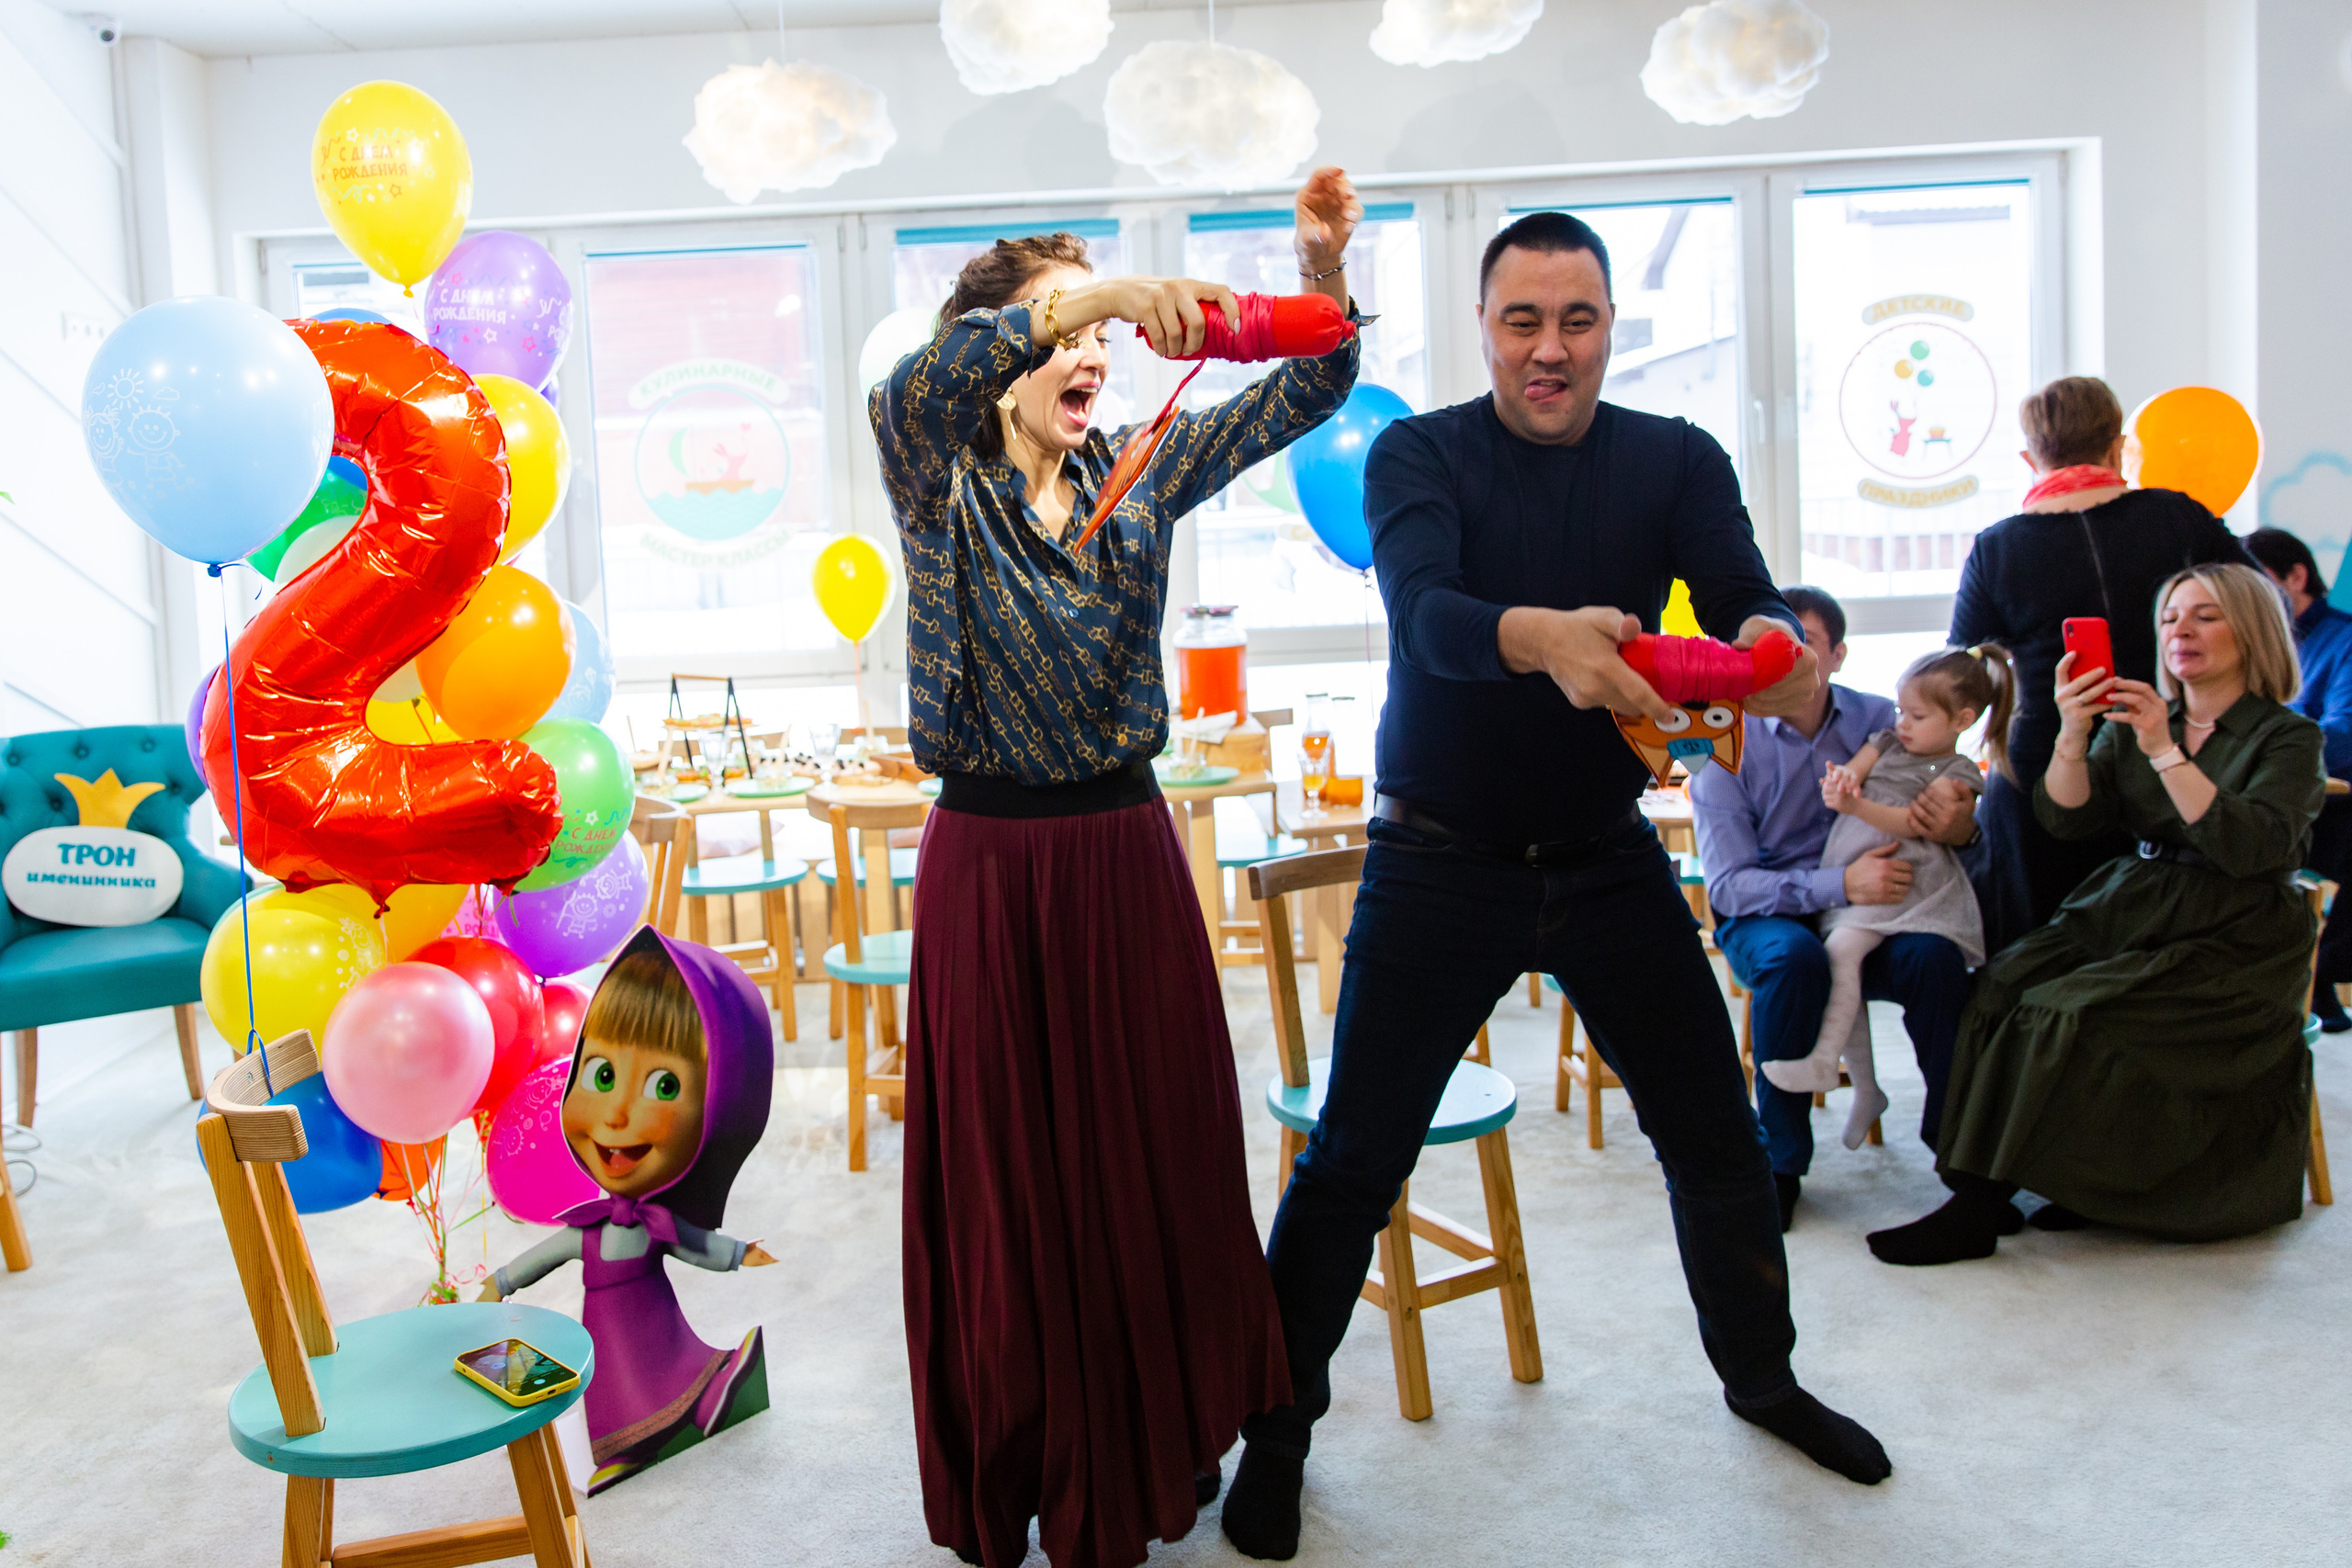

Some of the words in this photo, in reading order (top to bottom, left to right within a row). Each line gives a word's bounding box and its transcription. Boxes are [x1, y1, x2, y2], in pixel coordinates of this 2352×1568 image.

[339, 147, 346, 162] С
[333, 163, 408, 181] РОЖДЕНИЯ
[440, 288, 448, 303] С
[450, 288, 494, 305] ДНМ
[433, 307, 506, 324] РОЖДЕНИЯ
[1872, 295, 1965, 322] ДЕТСКИЕ
[639, 364, 776, 397] КУЛИНАРНЫЕ
[1860, 479, 1975, 508] ПРАЗДНИКИ
[639, 532, 713, 567] МАСТЕР
[718, 528, 790, 567] КЛАССЫ
[571, 827, 582, 840] С
[57, 843, 136, 867] ТРОН
[27, 872, 156, 888] именинника
